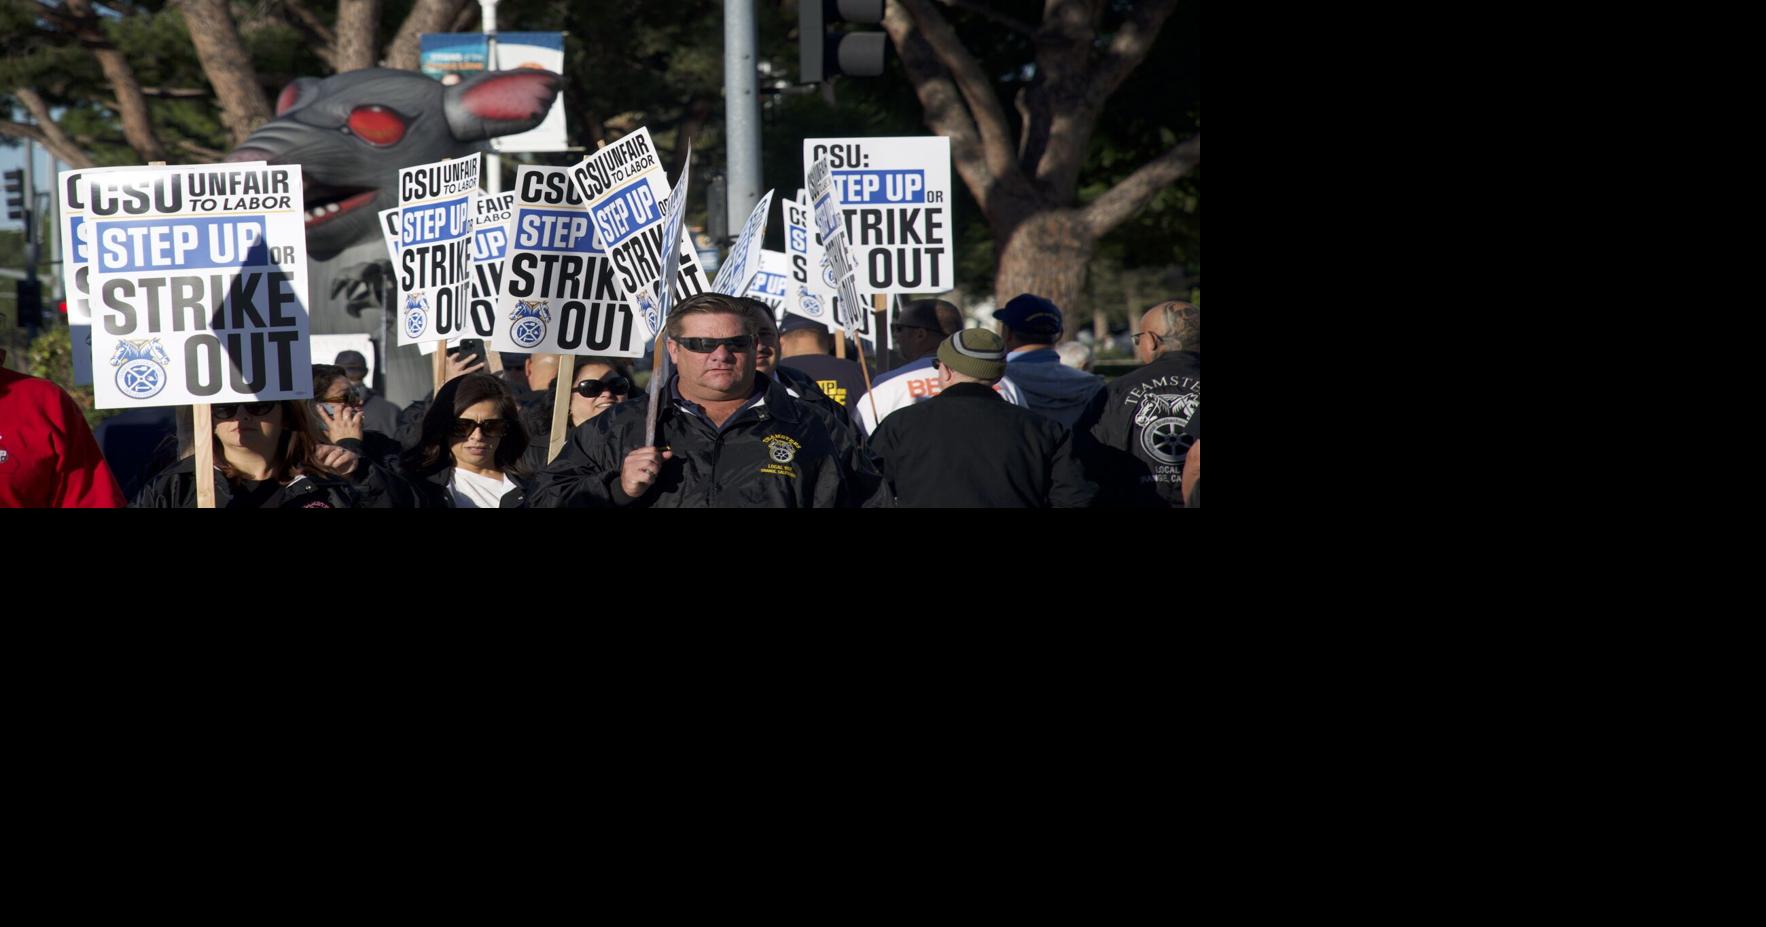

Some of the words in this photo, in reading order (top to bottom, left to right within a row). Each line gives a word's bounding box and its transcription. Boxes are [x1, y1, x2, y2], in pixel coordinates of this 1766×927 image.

[575, 152, 611, 201] CSU
[606, 134, 650, 171] UNFAIR
[611, 169, 624, 184] TO
[625, 155, 655, 176] LABOR
[813, 144, 869, 168] CSU:
[91, 171, 183, 216] CSU
[188, 169, 290, 197] UNFAIR
[403, 167, 441, 202] CSU
[444, 157, 478, 183] UNFAIR
[444, 184, 456, 195] TO
[457, 177, 477, 191] LABOR
[886, 173, 922, 201] UP
[927, 191, 943, 203] OR
[189, 198, 216, 212] TO
[223, 196, 291, 211] LABOR
[403, 207, 446, 243] STEP
[450, 202, 468, 236] UP
[597, 203, 630, 243] STEP
[626, 184, 655, 226] UP
[102, 224, 199, 269] STEP
[208, 221, 262, 265] UP
[269, 245, 296, 266] OR
[520, 214, 588, 249] STEP
[816, 208, 943, 247] TRIKE
[402, 237, 471, 292] STRIKE
[508, 252, 626, 302] STRIK
[868, 247, 945, 289] OUT
[102, 271, 297, 336] STRIKE
[436, 281, 470, 335] OUT
[557, 300, 634, 352] OUT
[184, 330, 299, 397] OUT
[1154, 465, 1180, 474] LOCAL
